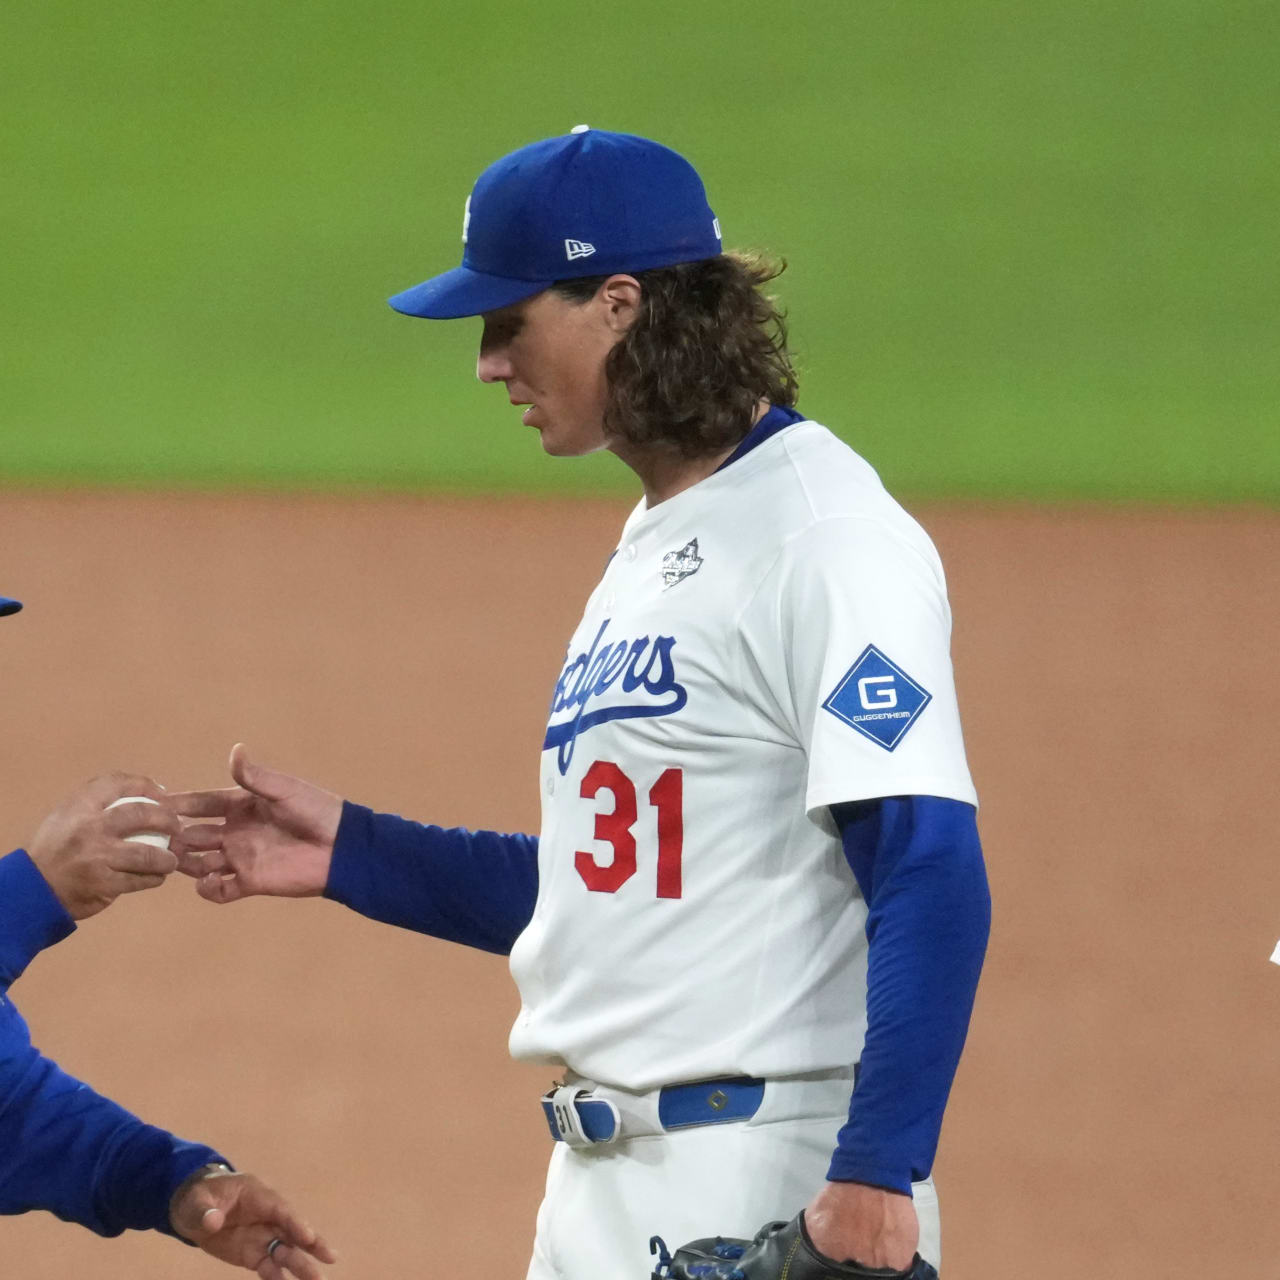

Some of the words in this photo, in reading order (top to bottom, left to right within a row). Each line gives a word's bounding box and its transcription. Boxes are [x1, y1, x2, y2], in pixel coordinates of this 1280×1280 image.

[857, 675, 898, 710] G
[853, 711, 911, 722] GUGGENHEIM
[574, 760, 683, 899] 31
[555, 1104, 573, 1134] 31
